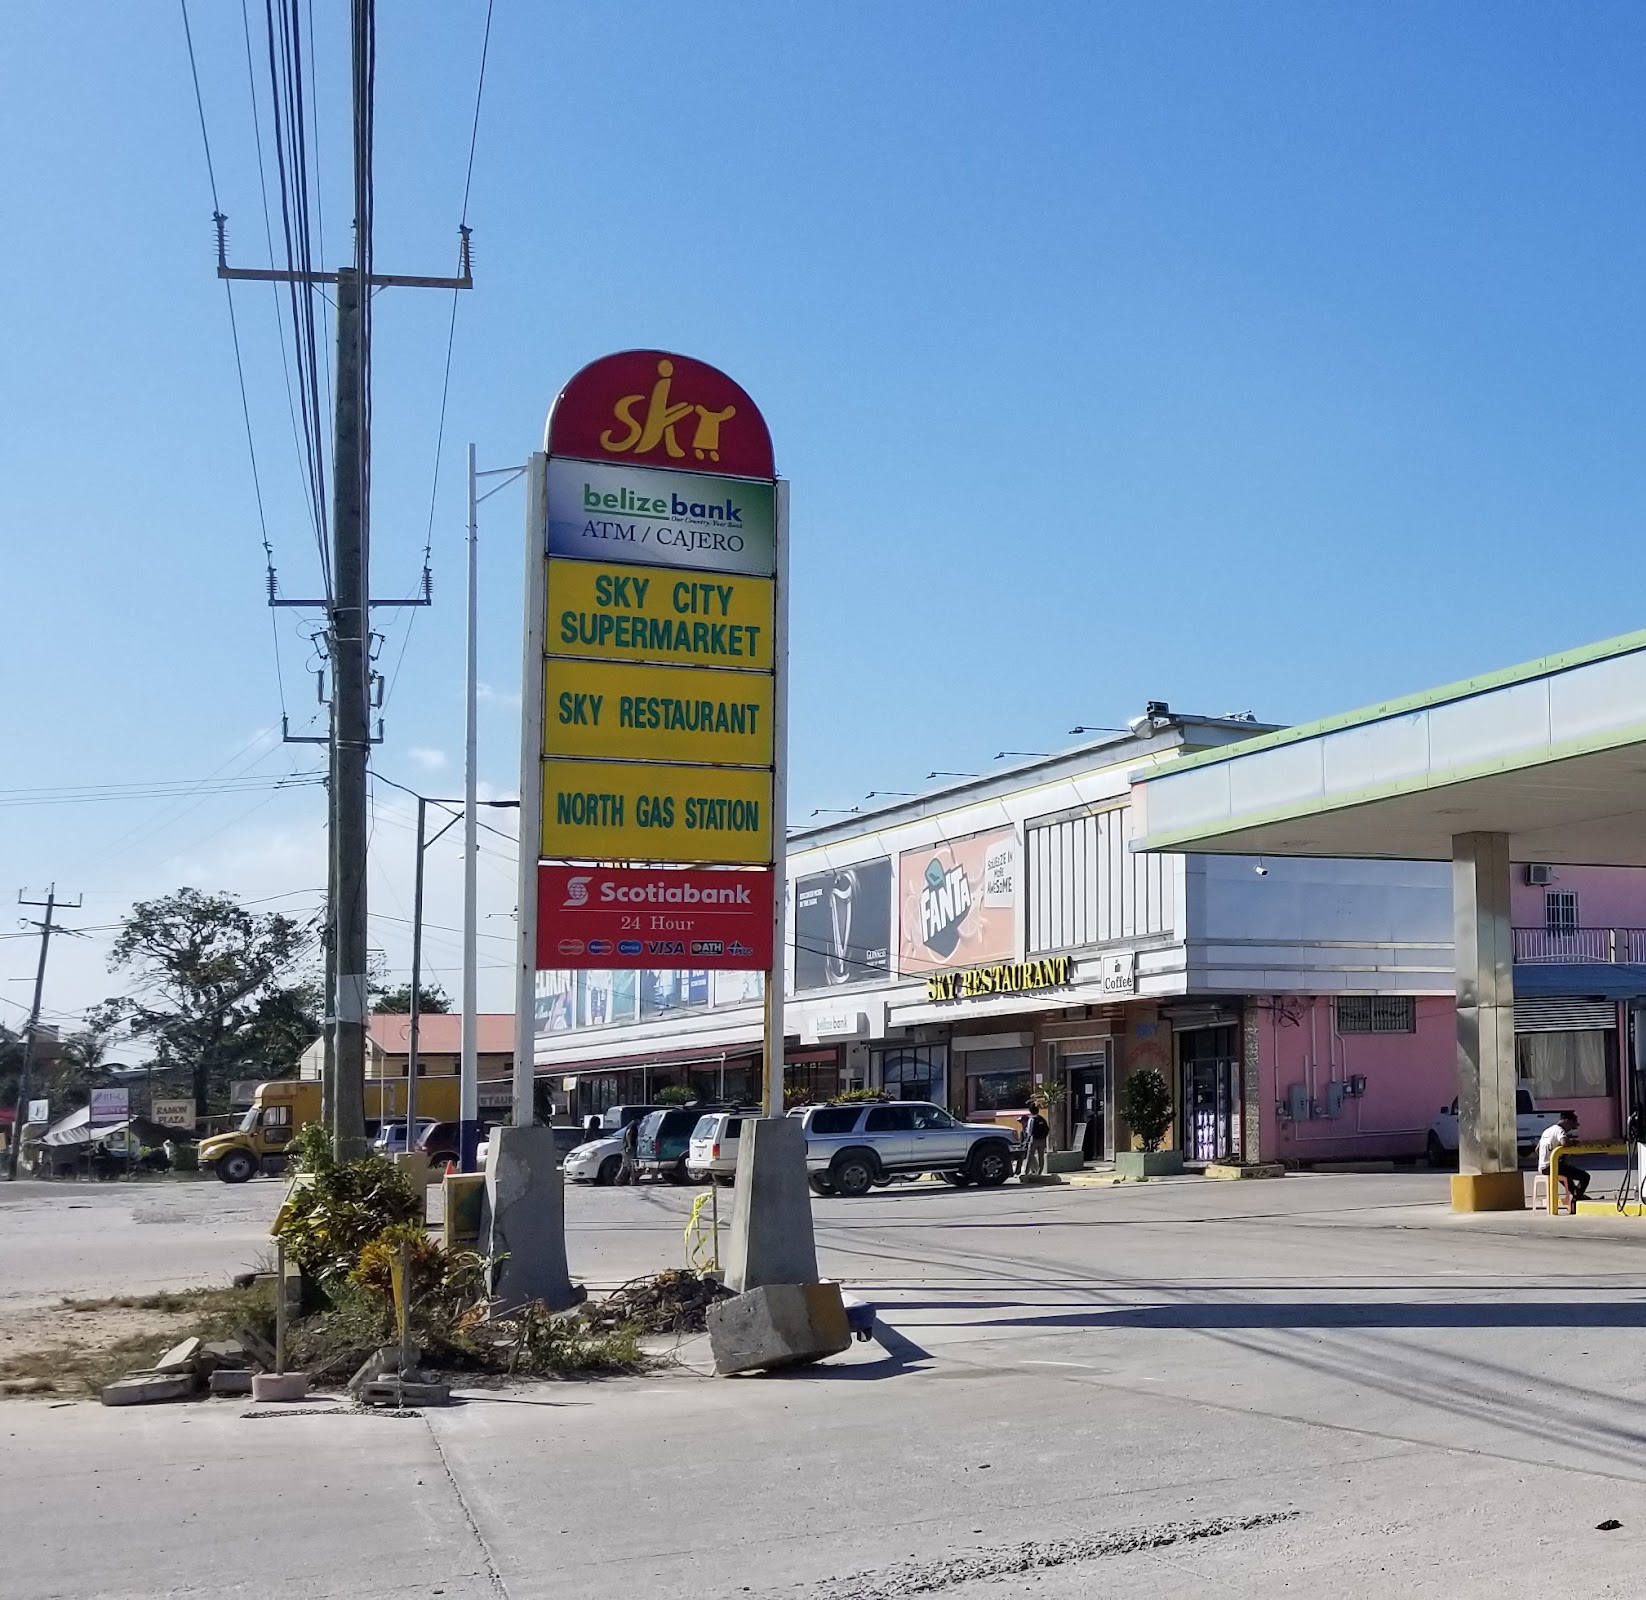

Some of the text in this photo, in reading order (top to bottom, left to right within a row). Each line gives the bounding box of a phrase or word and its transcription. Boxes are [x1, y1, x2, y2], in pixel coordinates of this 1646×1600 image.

[583, 483, 743, 522] belize bank
[582, 520, 636, 541] ATM
[656, 527, 744, 553] CAJERO
[595, 575, 734, 616] SKY CITY
[560, 611, 761, 657] SUPERMARKET
[559, 692, 760, 735] SKY RESTAURANT
[557, 792, 759, 832] NORTH GAS STATION
[600, 881, 751, 904] Scotiabank
[920, 864, 972, 944] FANTA
[620, 915, 694, 931] 24 Hour
[646, 940, 685, 955] VISA
[702, 942, 722, 952] ATH
[926, 956, 1067, 1001] SKY RESTAURANT
[1104, 976, 1133, 991] Coffee
